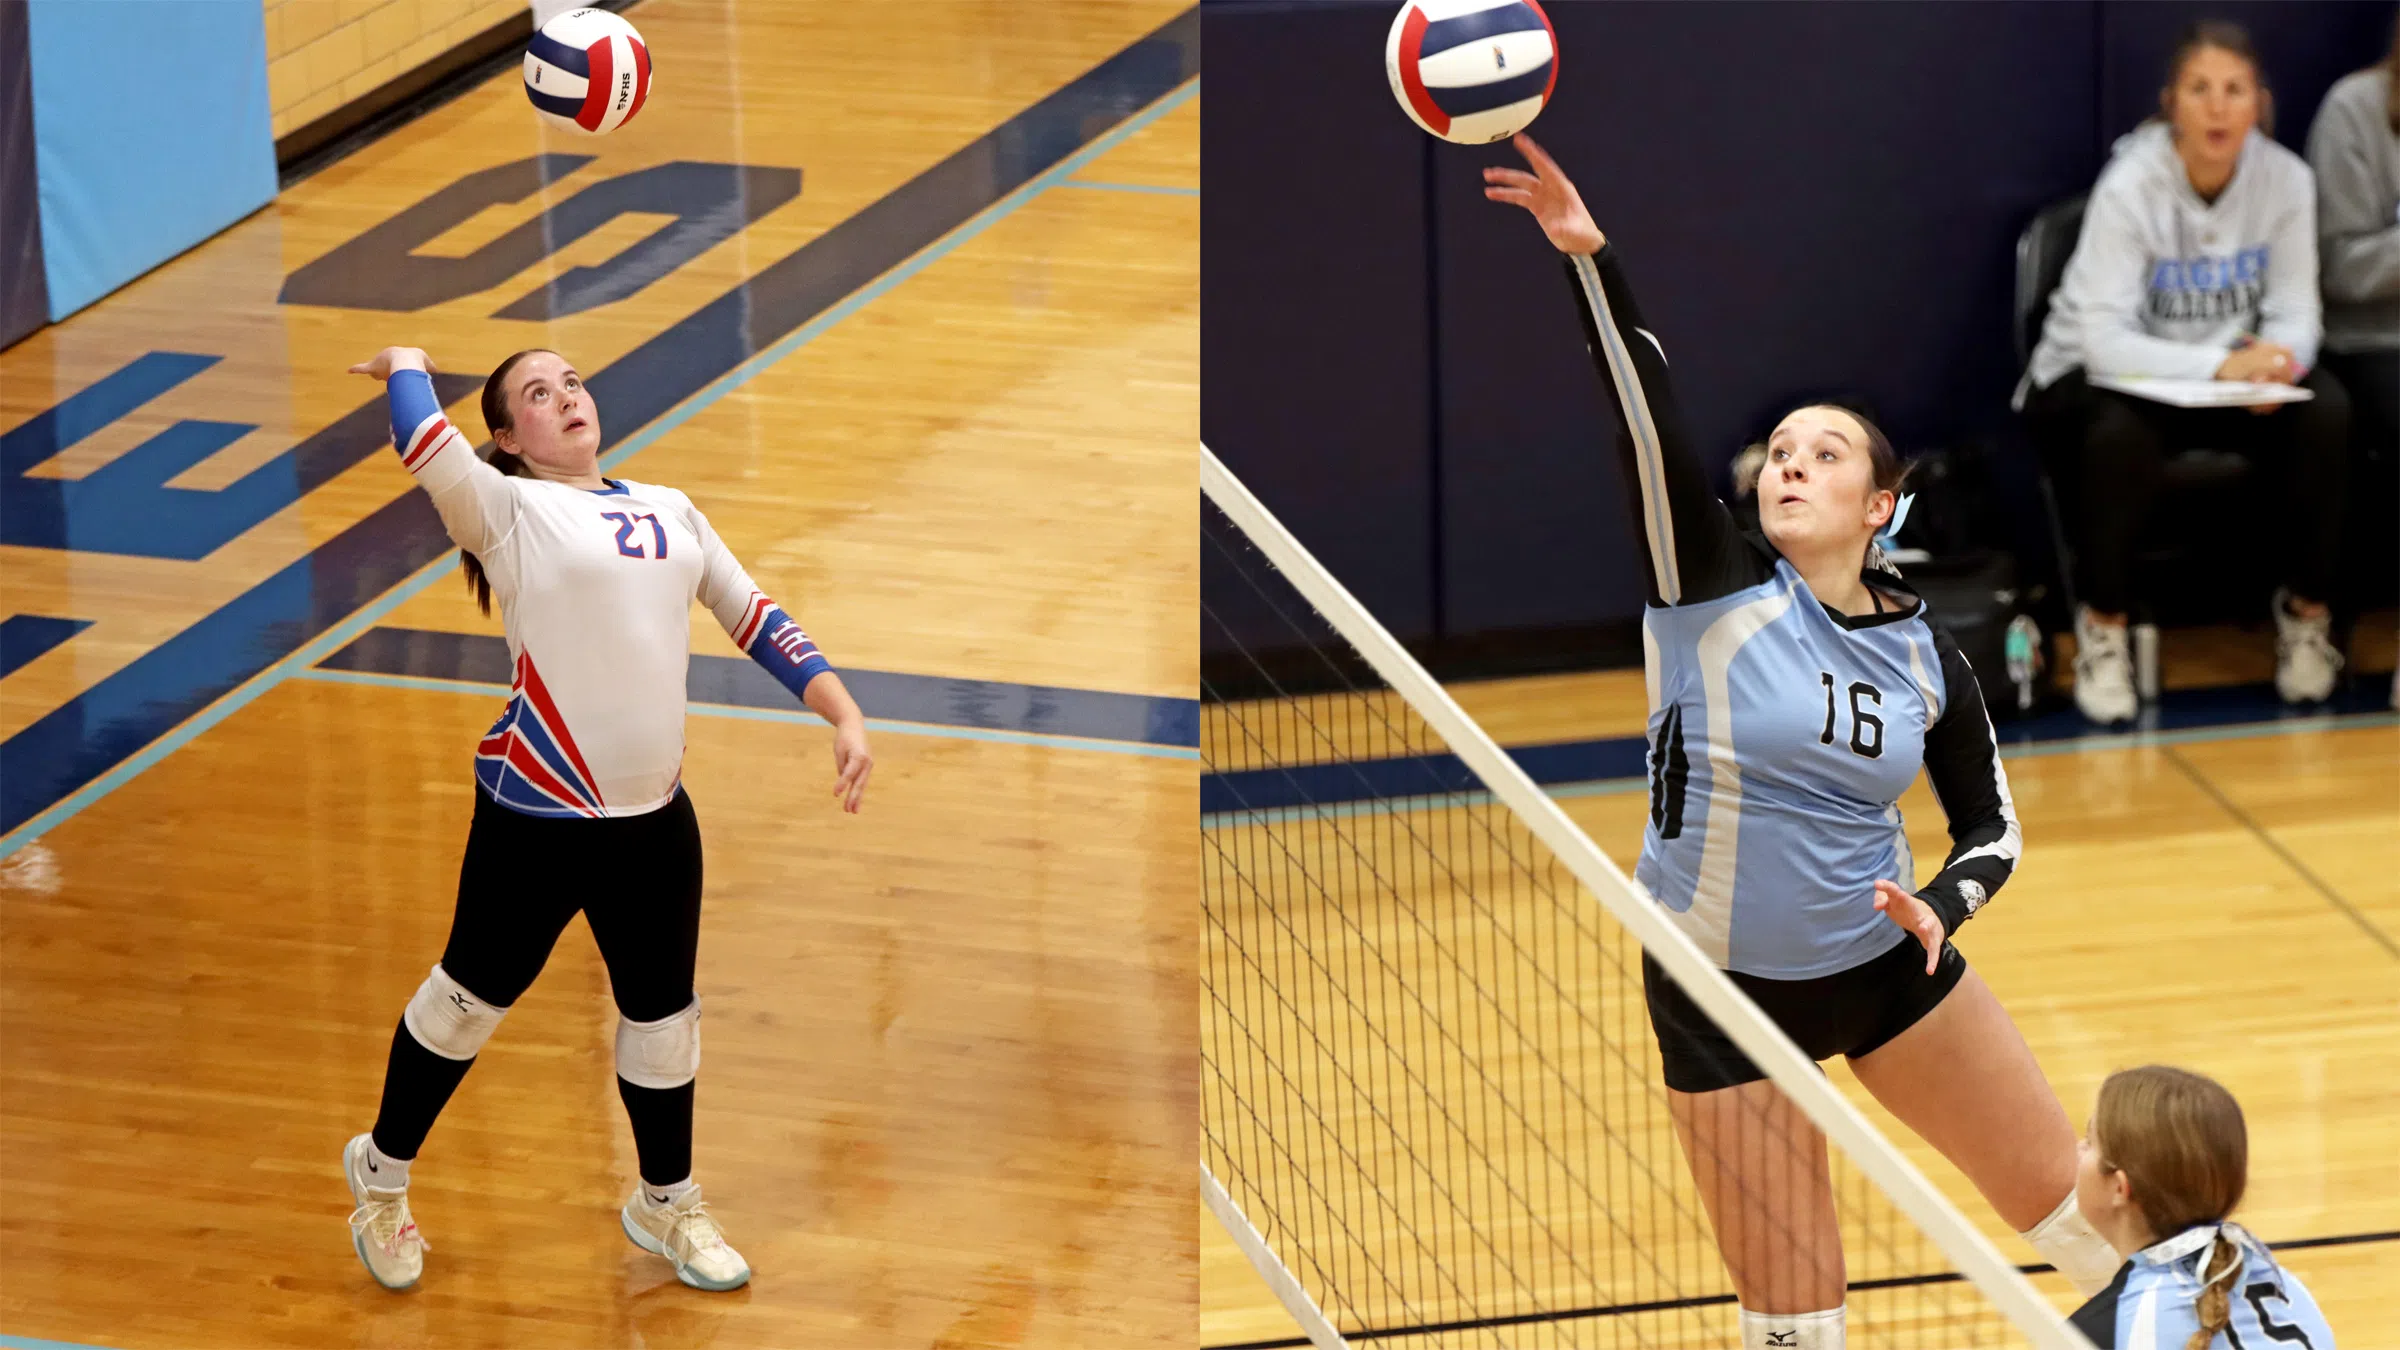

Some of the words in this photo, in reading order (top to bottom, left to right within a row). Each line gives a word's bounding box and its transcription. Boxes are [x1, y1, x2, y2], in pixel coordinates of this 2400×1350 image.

[619, 73, 630, 102] NFHS
[0, 152, 802, 680] ES
[600, 512, 668, 560] 27
[1820, 671, 1884, 760] 16
